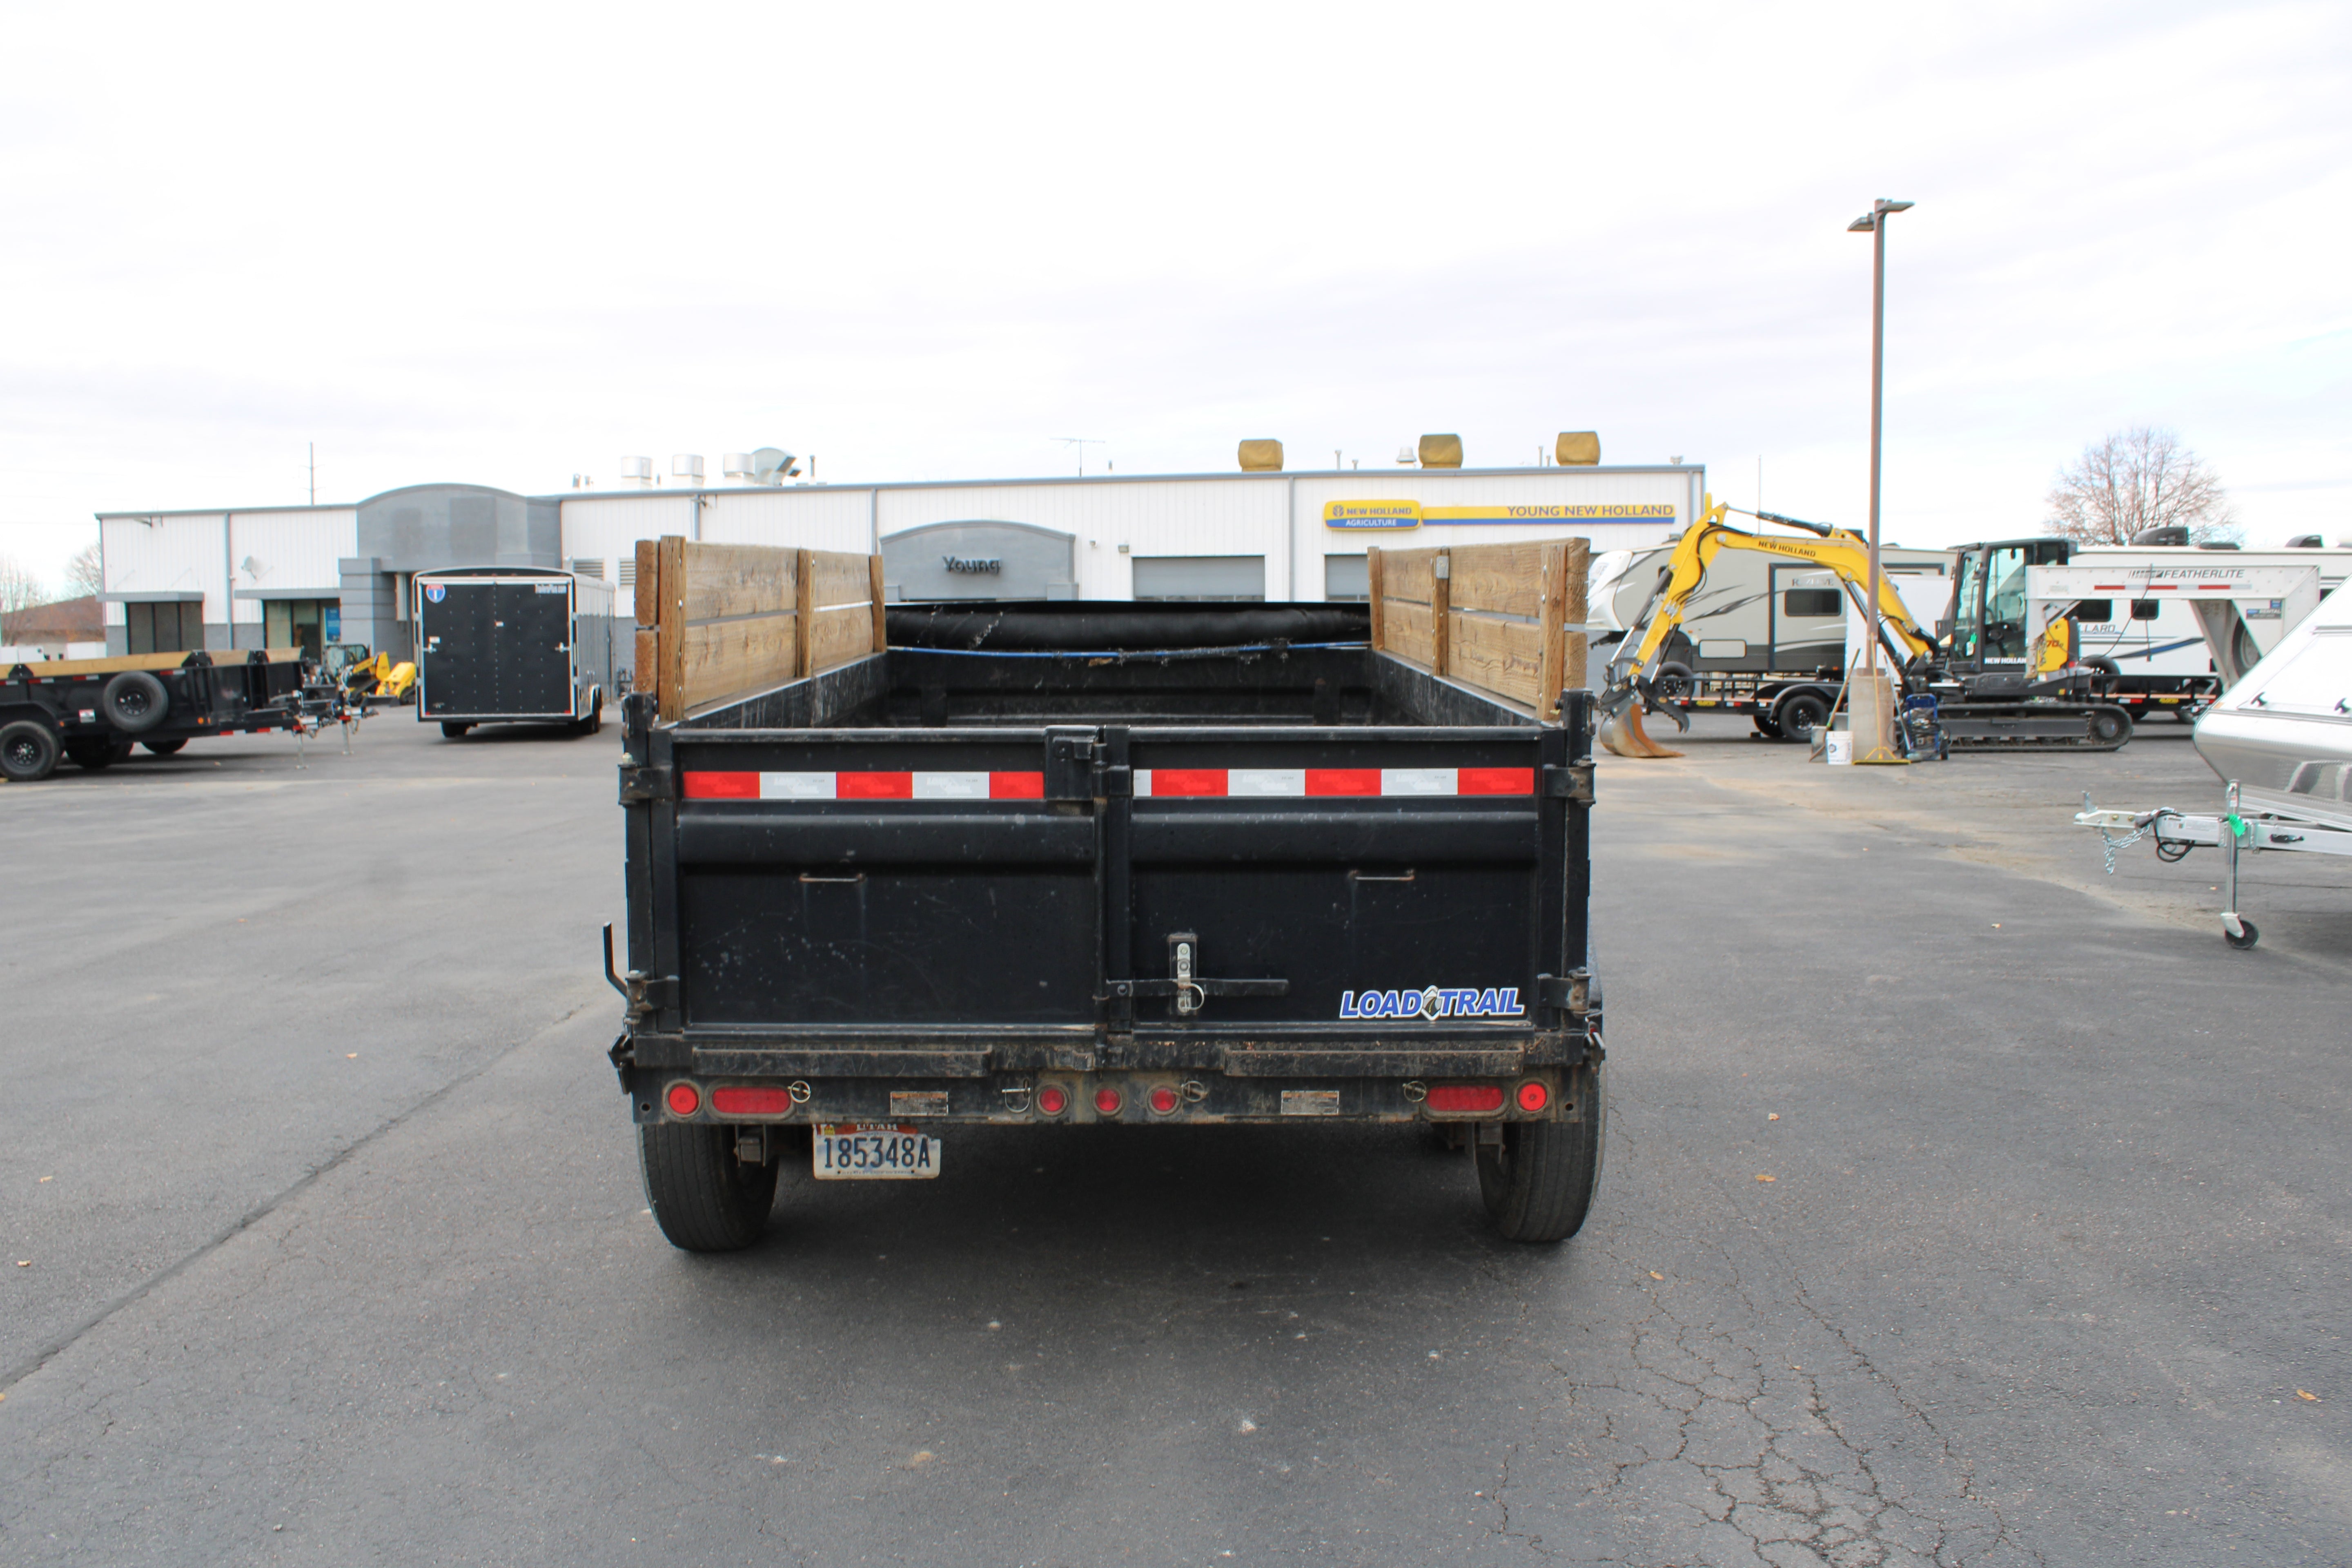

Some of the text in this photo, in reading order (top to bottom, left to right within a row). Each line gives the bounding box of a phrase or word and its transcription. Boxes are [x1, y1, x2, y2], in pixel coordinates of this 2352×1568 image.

[1508, 505, 1673, 517] YOUNG NEW HOLLAND
[1758, 540, 1816, 557] NEW HOLLAND
[942, 556, 1001, 574] Young
[2164, 569, 2245, 578] FEATHERLITE
[2077, 624, 2116, 633] LLARD
[1340, 988, 1525, 1019] LOAD TRAIL
[824, 1137, 930, 1168] 185348A
